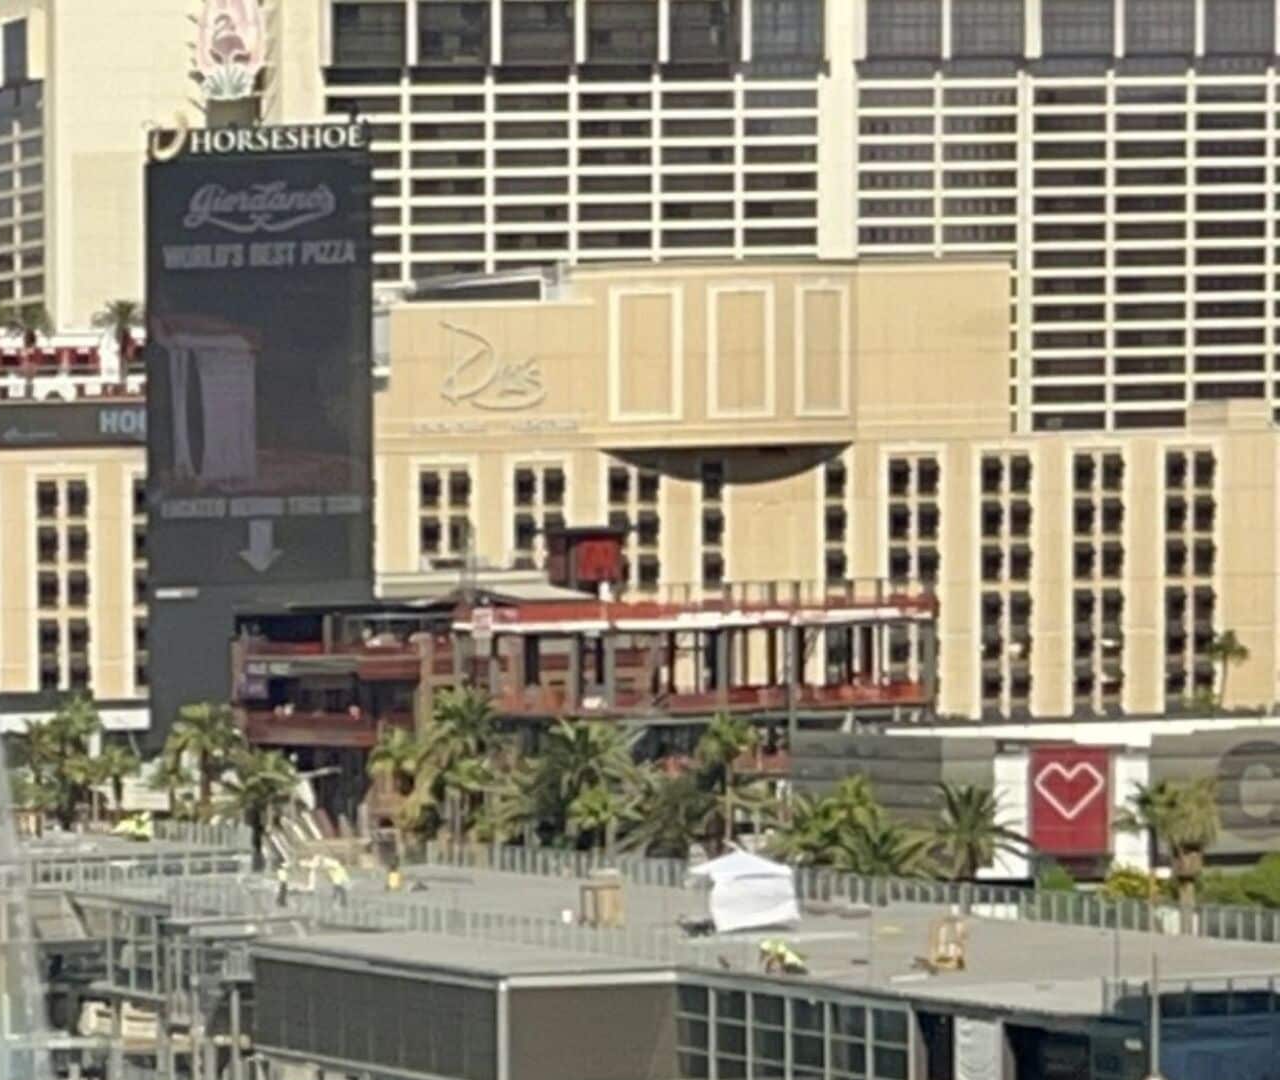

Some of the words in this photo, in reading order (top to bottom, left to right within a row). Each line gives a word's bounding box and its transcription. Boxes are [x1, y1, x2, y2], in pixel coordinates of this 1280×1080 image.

[191, 125, 366, 154] HORSESHOE
[161, 243, 244, 270] WORLD'S
[248, 241, 297, 268] BEST
[301, 239, 356, 265] PIZZA
